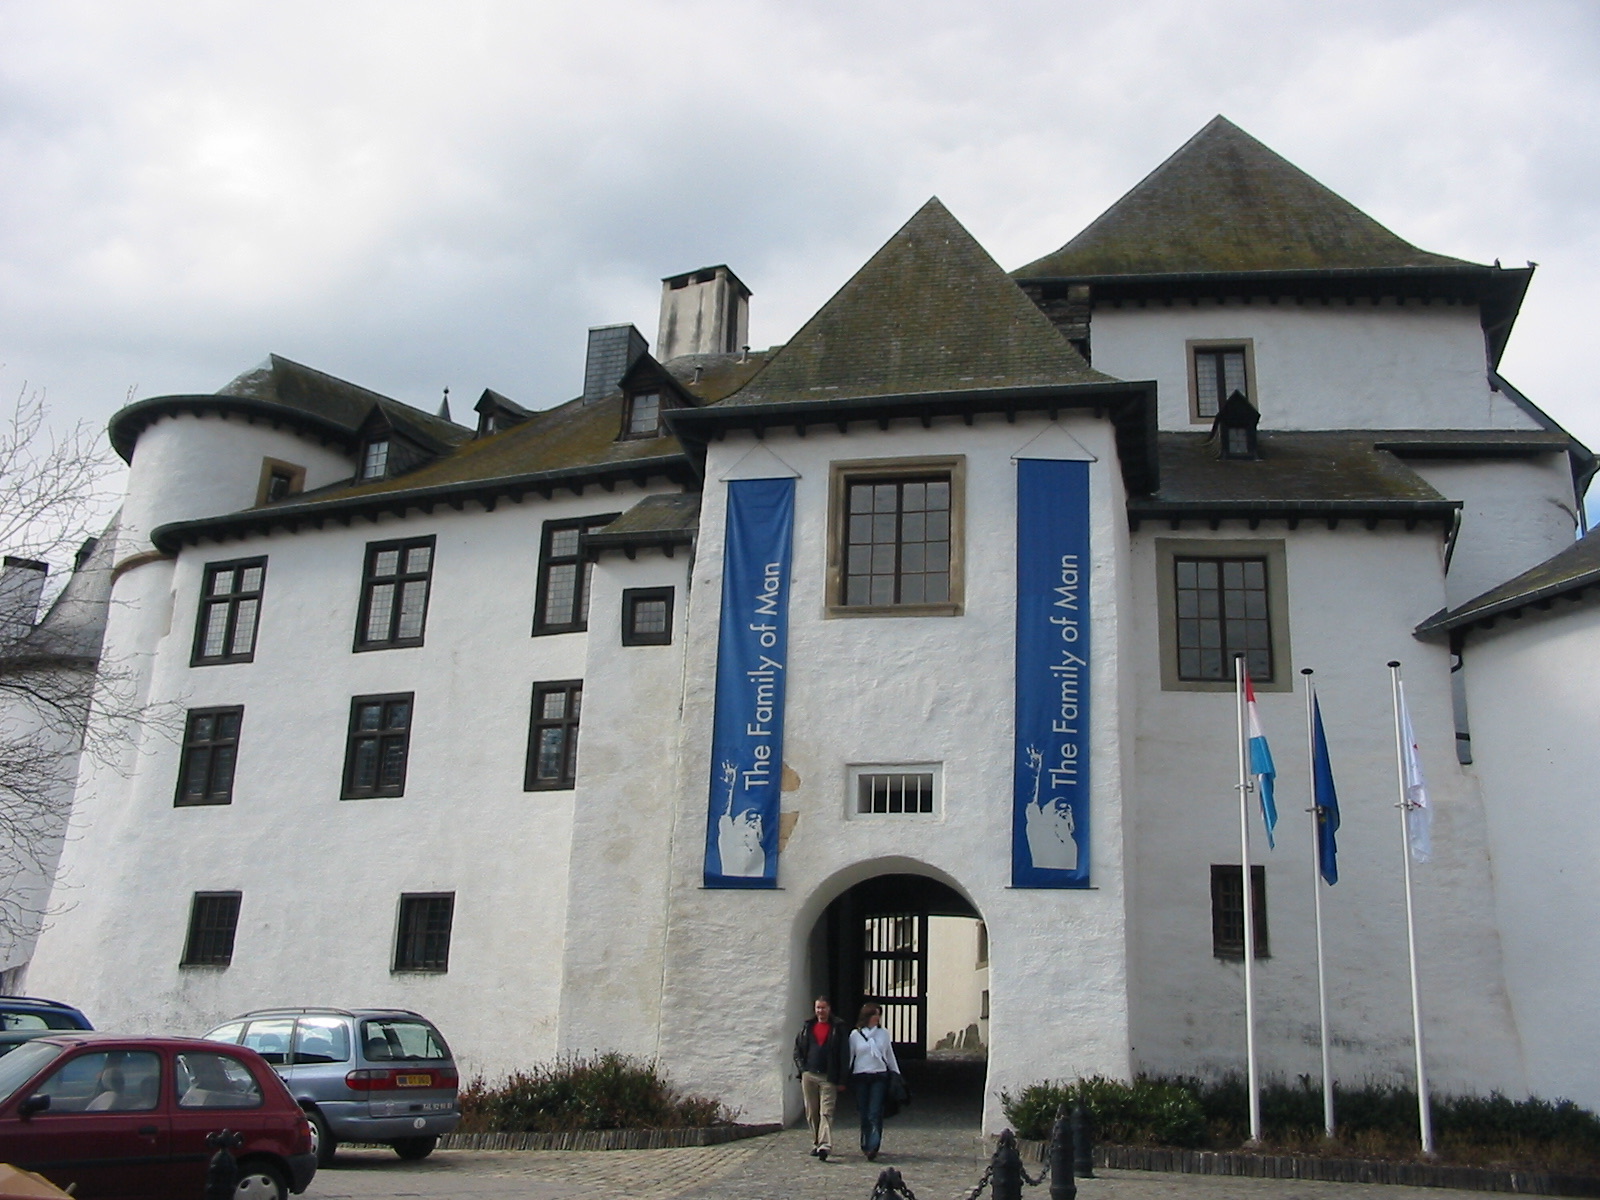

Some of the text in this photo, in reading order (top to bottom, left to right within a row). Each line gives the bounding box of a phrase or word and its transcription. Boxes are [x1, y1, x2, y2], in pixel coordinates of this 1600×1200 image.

[742, 562, 782, 791] The Family of Man
[1048, 555, 1086, 790] The Family of Man
